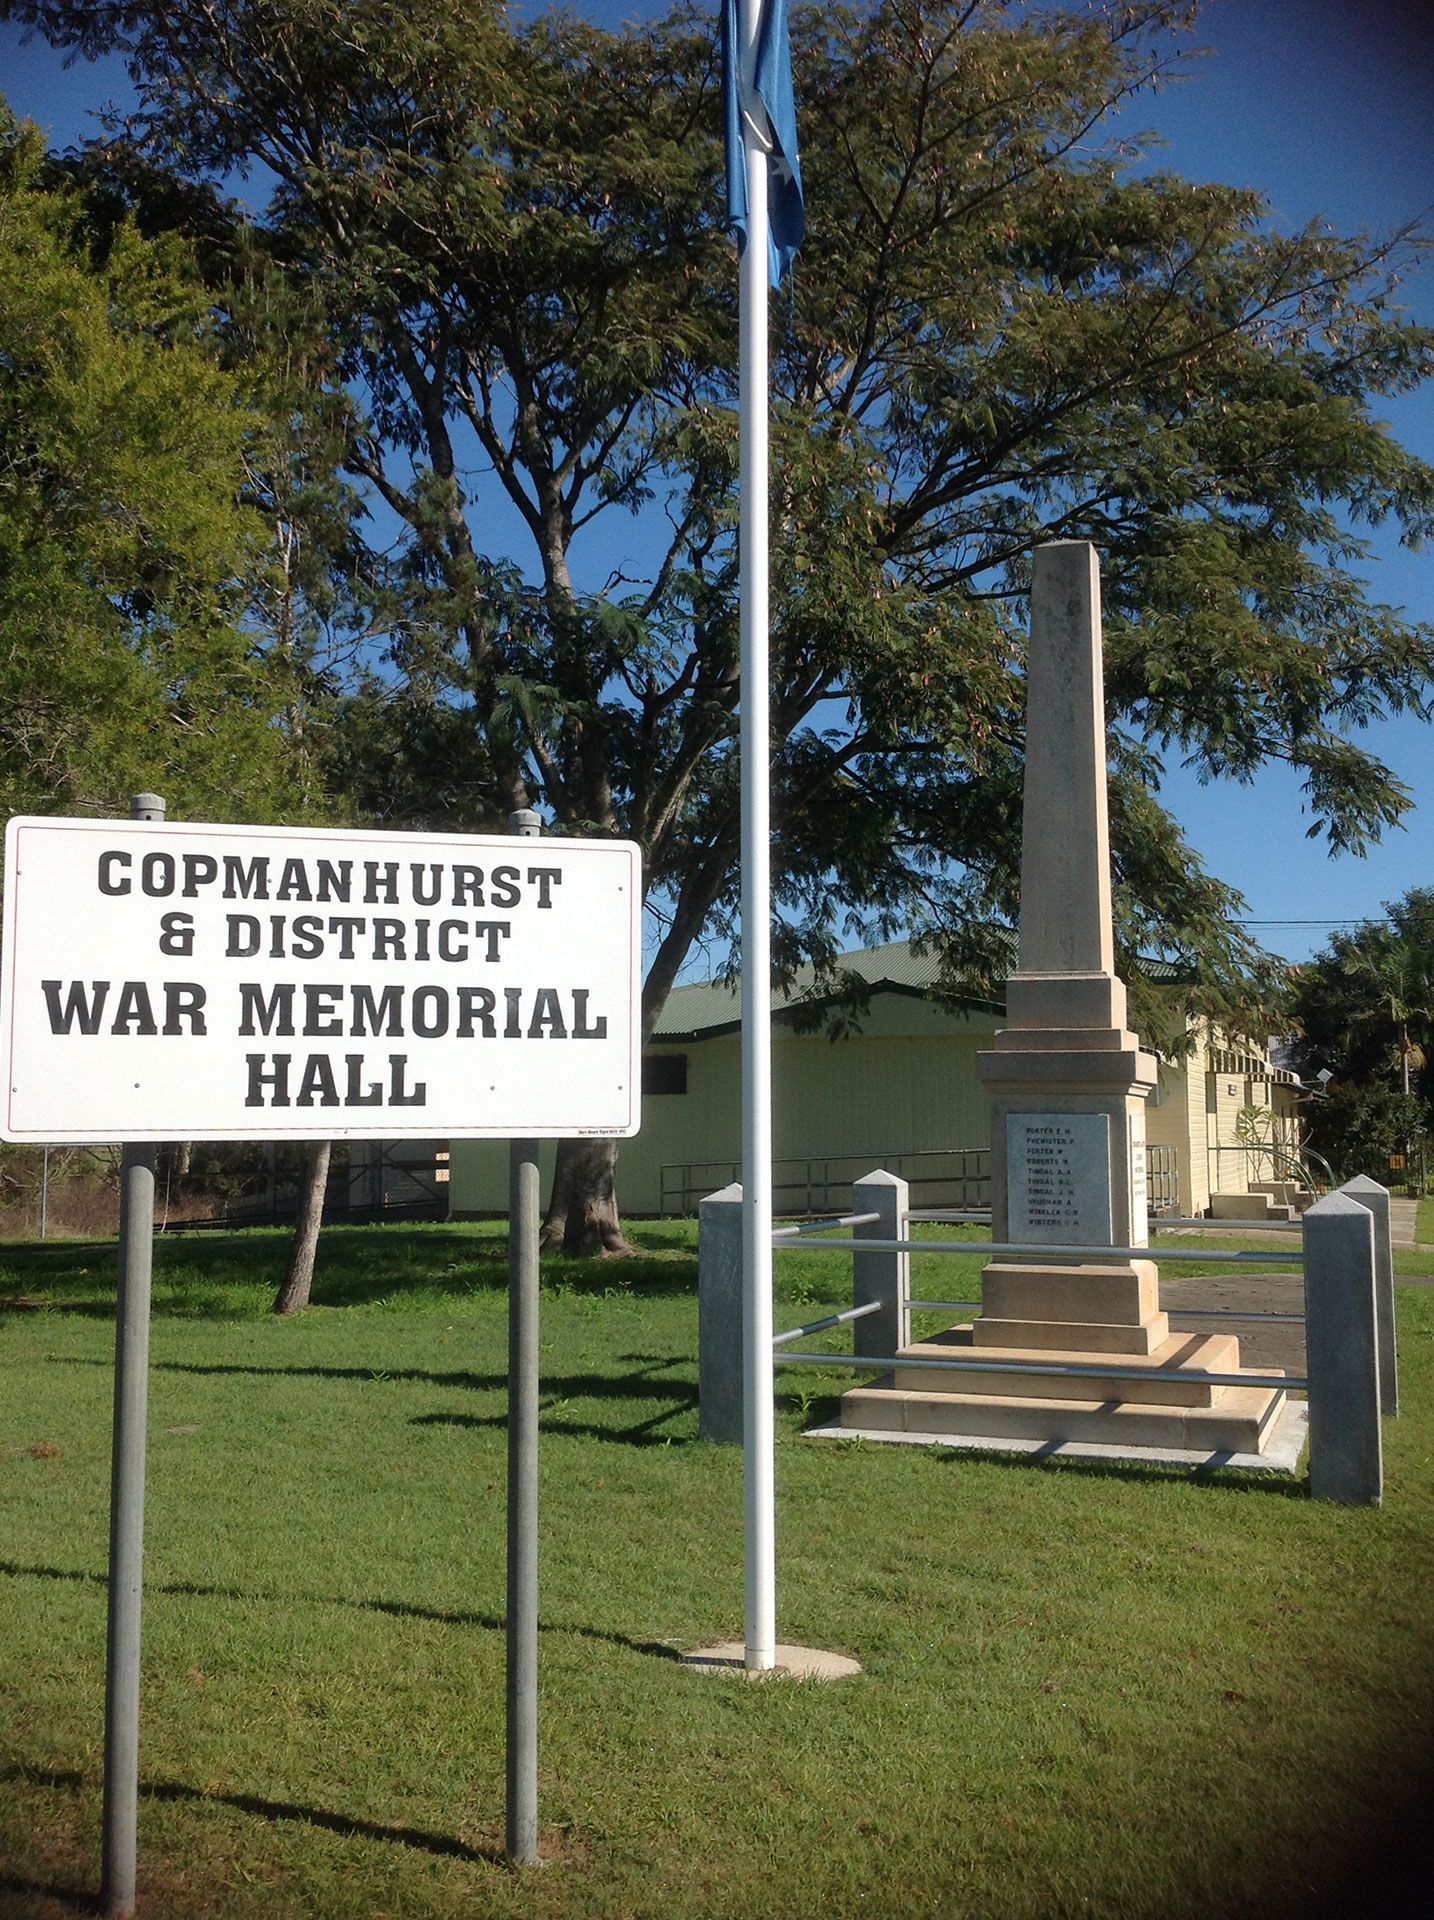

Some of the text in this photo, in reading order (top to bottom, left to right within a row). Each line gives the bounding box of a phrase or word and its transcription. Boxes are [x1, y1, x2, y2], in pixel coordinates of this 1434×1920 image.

[98, 850, 562, 909] COPMANHURST
[159, 912, 511, 962] & DISTRICT
[41, 980, 608, 1039] WAR MEMORIAL
[245, 1053, 427, 1108] HALL
[1026, 1127, 1054, 1135] PORTER
[1027, 1198, 1062, 1206] VAUGHAN
